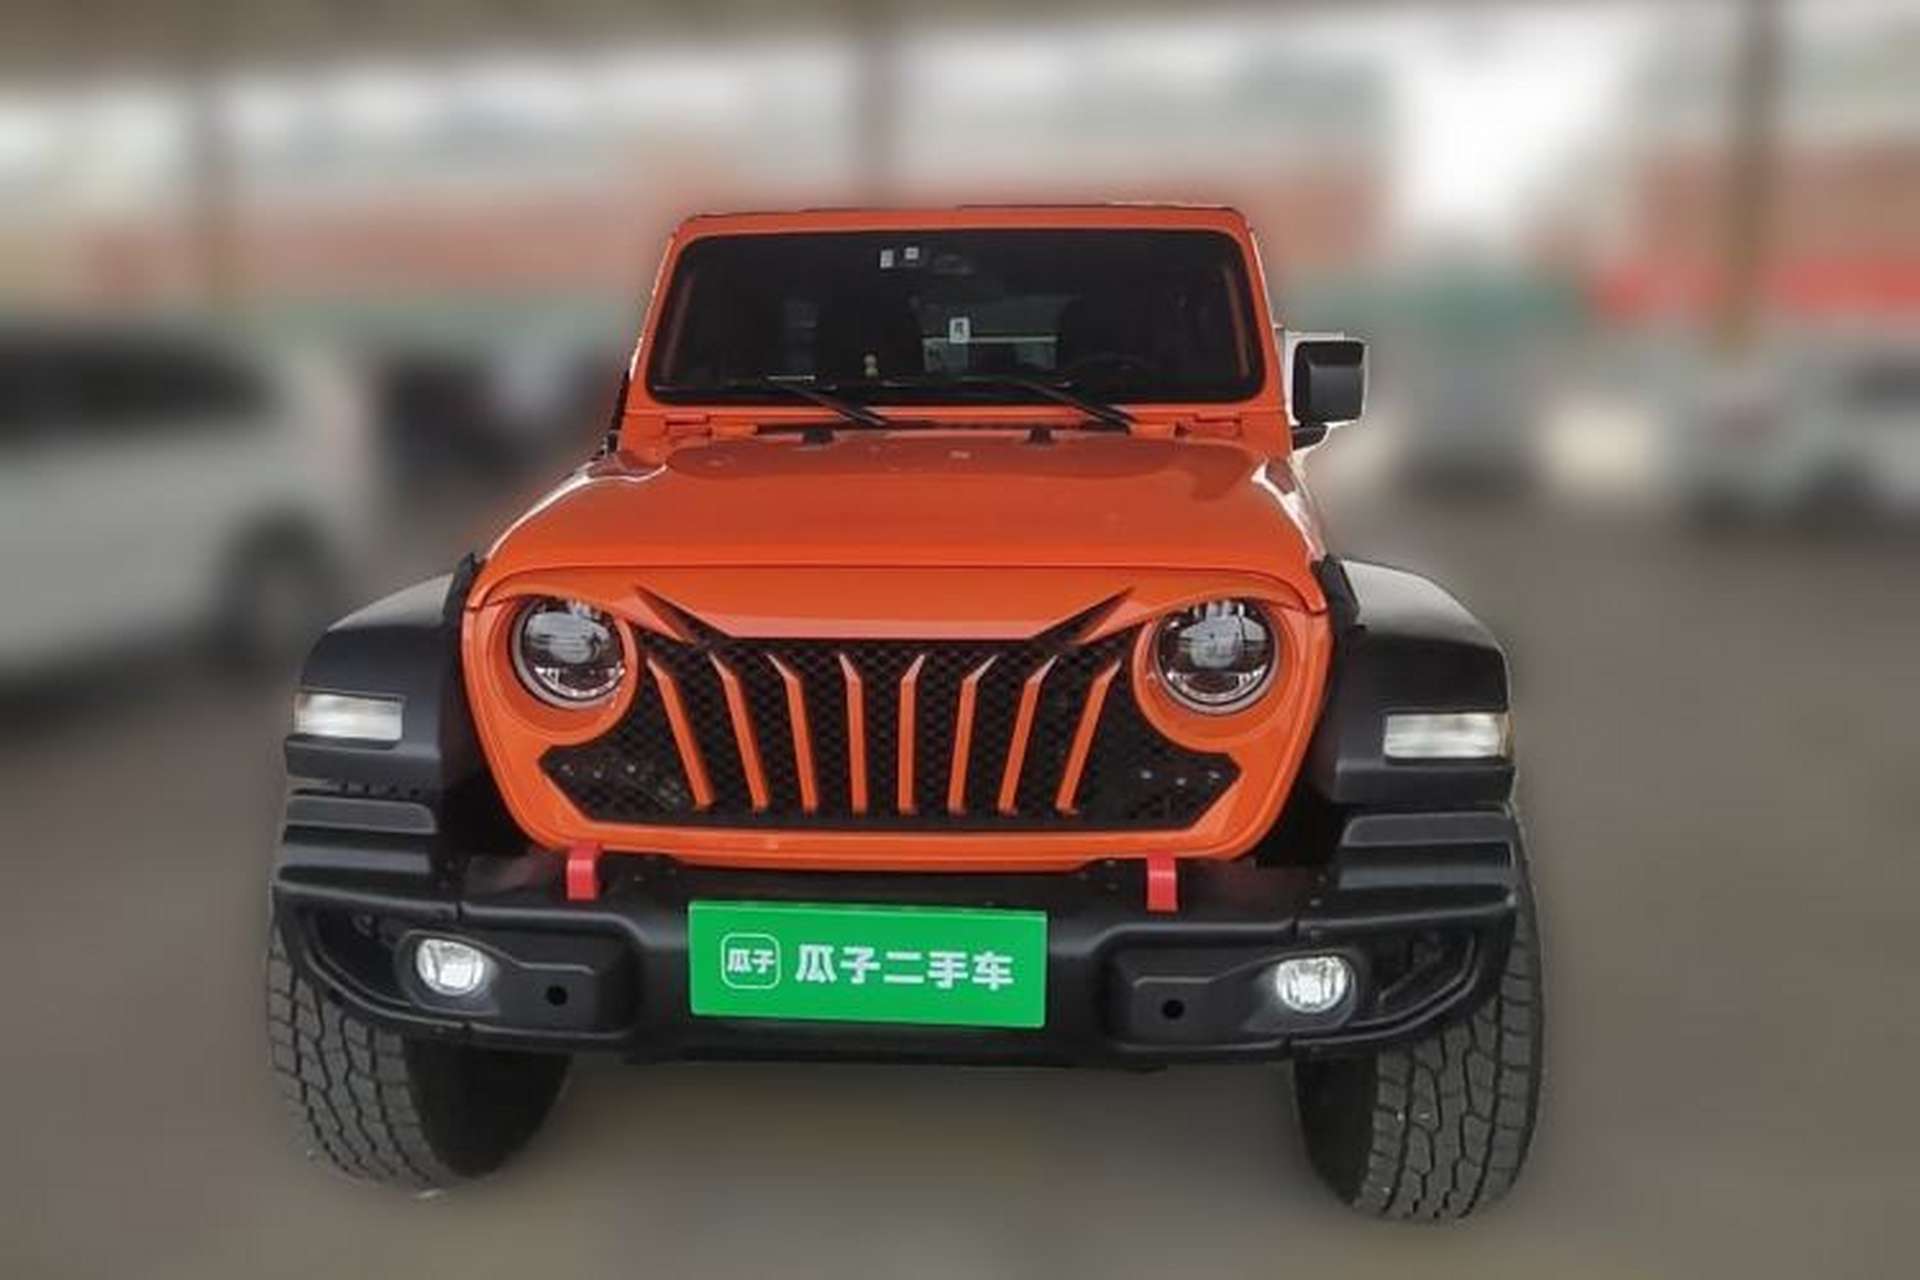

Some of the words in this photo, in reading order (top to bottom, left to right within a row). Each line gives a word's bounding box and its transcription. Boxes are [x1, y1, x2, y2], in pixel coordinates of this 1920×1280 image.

[727, 948, 775, 974] 瓜子
[796, 944, 1013, 990] 瓜子二手车
